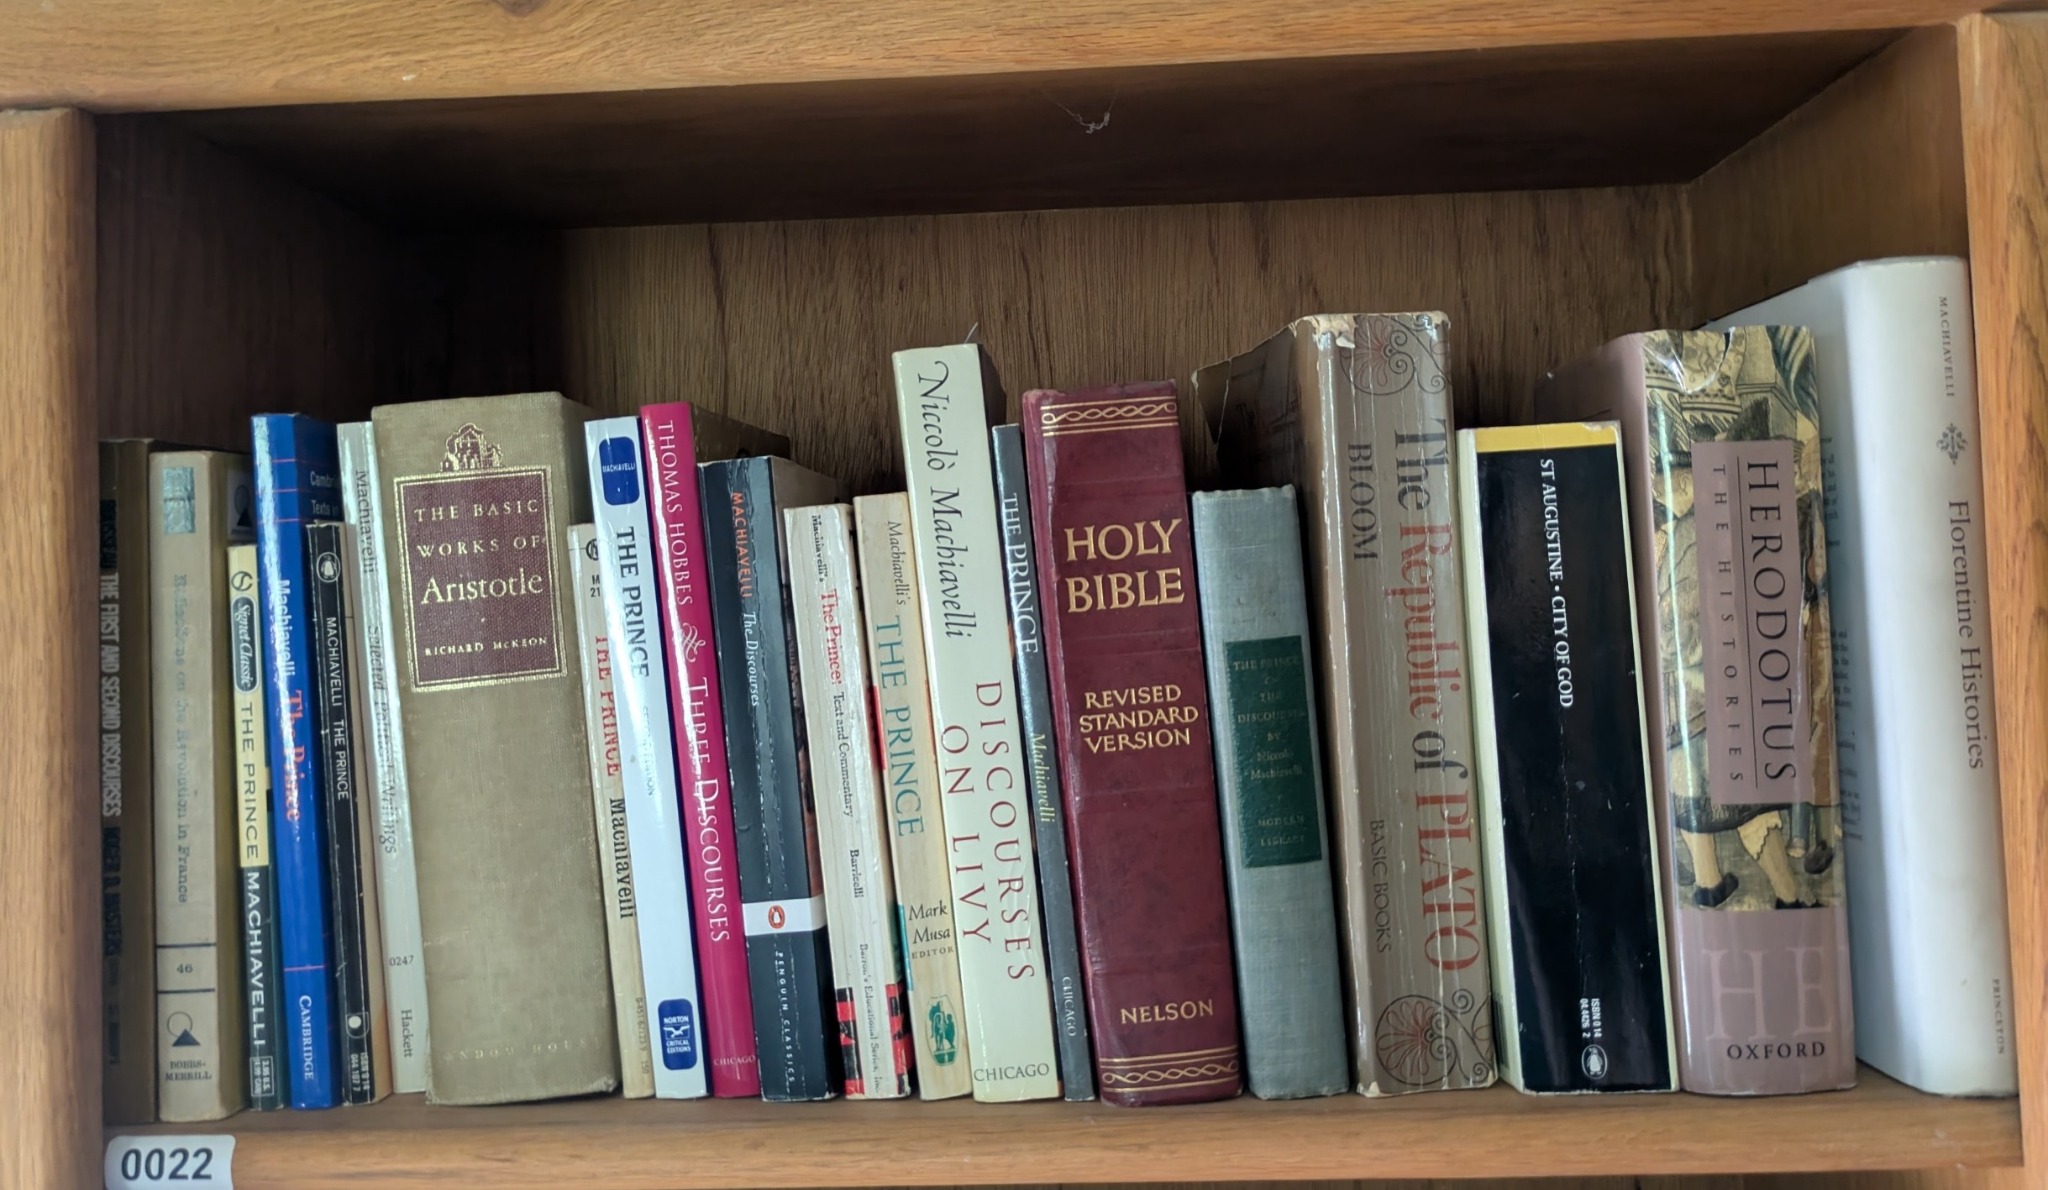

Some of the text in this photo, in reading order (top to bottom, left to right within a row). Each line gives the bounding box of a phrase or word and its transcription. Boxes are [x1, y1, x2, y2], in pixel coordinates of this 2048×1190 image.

[602, 462, 635, 473] MACHIAVELLI
[657, 420, 683, 513] THOMAS
[414, 500, 538, 522] THE BASIC
[917, 360, 977, 639] Niccolò Machiavelli
[1347, 442, 1380, 561] BLOOM
[417, 535, 540, 558] WORKS OF
[1064, 518, 1183, 561] HOLY
[1938, 296, 1987, 770] MACHIAVELLI Florentine Histories
[101, 572, 119, 599] THE
[421, 567, 544, 605] Aristotle
[668, 522, 693, 606] HOBBES
[1004, 493, 1039, 653] THE PRINCE
[1539, 458, 1574, 708] ST AUGUSTINE CITY OF GOD
[616, 526, 649, 678] THE PRINCE
[732, 491, 762, 707] MACHIAVELLI The Discourses
[820, 588, 840, 623] The
[1065, 567, 1185, 613] BIBLE
[101, 604, 119, 642] FIRST
[238, 602, 254, 689] Signet Classic
[276, 579, 295, 676] Machiavelli
[1712, 463, 1744, 783] THE HISTORIES
[1746, 459, 1798, 782] HERODOTUS
[101, 645, 120, 672] AND
[425, 642, 484, 657] RICHARD
[1233, 660, 1258, 671] THE
[102, 676, 120, 730] SECOND
[832, 691, 846, 717] Text
[876, 521, 925, 837] Machiavelli's THE PRINCE
[1085, 684, 1182, 709] REVISED
[1385, 418, 1481, 971] The Republic of PLATO
[326, 617, 350, 800] MACHIAVELLI THE PRINCE
[600, 690, 621, 777] PRINCE
[835, 719, 849, 740] and
[1079, 705, 1199, 733] STANDARD
[1083, 728, 1191, 754] VERSION
[102, 733, 121, 816] DISCOURSES
[241, 702, 259, 858] THE PRINCE
[838, 743, 855, 818] Commentary
[1030, 733, 1056, 823] Machiavelli
[178, 824, 189, 840] in
[941, 725, 992, 943] ON LIVY
[975, 681, 1036, 980] DISCOURSES
[177, 845, 191, 903] France
[849, 849, 864, 898] Barricelli
[1368, 819, 1395, 954] BASIC BOOKS
[908, 904, 948, 921] Mark
[913, 929, 951, 945] Musa
[248, 872, 265, 1045] MACHIAVELLI
[389, 955, 414, 966] 0247
[663, 1015, 689, 1024] NORTON
[776, 952, 796, 1083] PENGUIN CLASSICS
[1061, 975, 1078, 1036] CHICAGO
[1120, 999, 1214, 1024] NELSON
[1591, 998, 1601, 1020] ISBN
[1992, 978, 2005, 1055] PRINCETON
[400, 1008, 414, 1059] Hackett
[666, 1039, 689, 1047] CRITICAL
[1593, 1028, 1602, 1038] 14
[1726, 1041, 1826, 1060] OXFORD
[714, 1055, 755, 1066] CHICAGO
[973, 1062, 1050, 1082] CHICAGO
[121, 1147, 213, 1181] 0022
